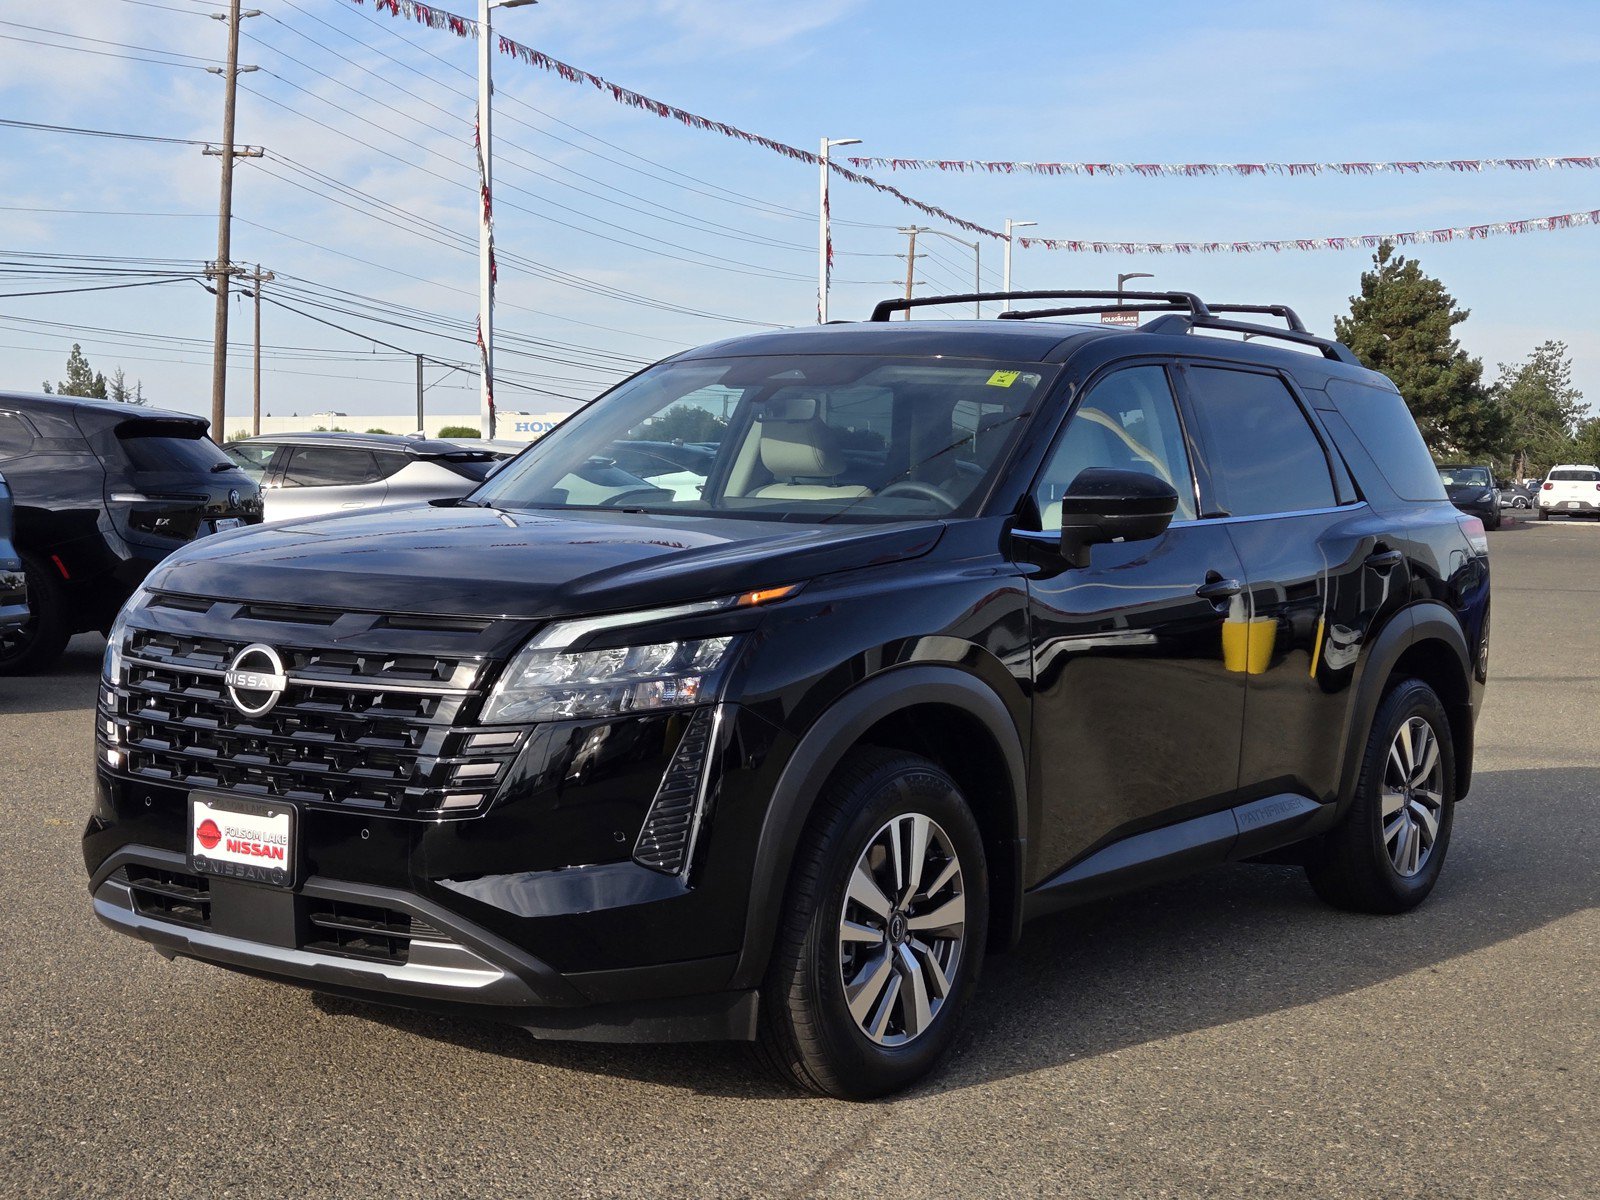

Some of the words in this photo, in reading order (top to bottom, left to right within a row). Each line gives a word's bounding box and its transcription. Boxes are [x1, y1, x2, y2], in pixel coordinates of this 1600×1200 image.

[514, 421, 559, 433] HON
[225, 672, 285, 690] NISSAN
[225, 825, 261, 842] FOLSOM
[263, 832, 288, 846] LAKE
[227, 838, 284, 860] NISSAN
[209, 860, 266, 880] NISSAN
